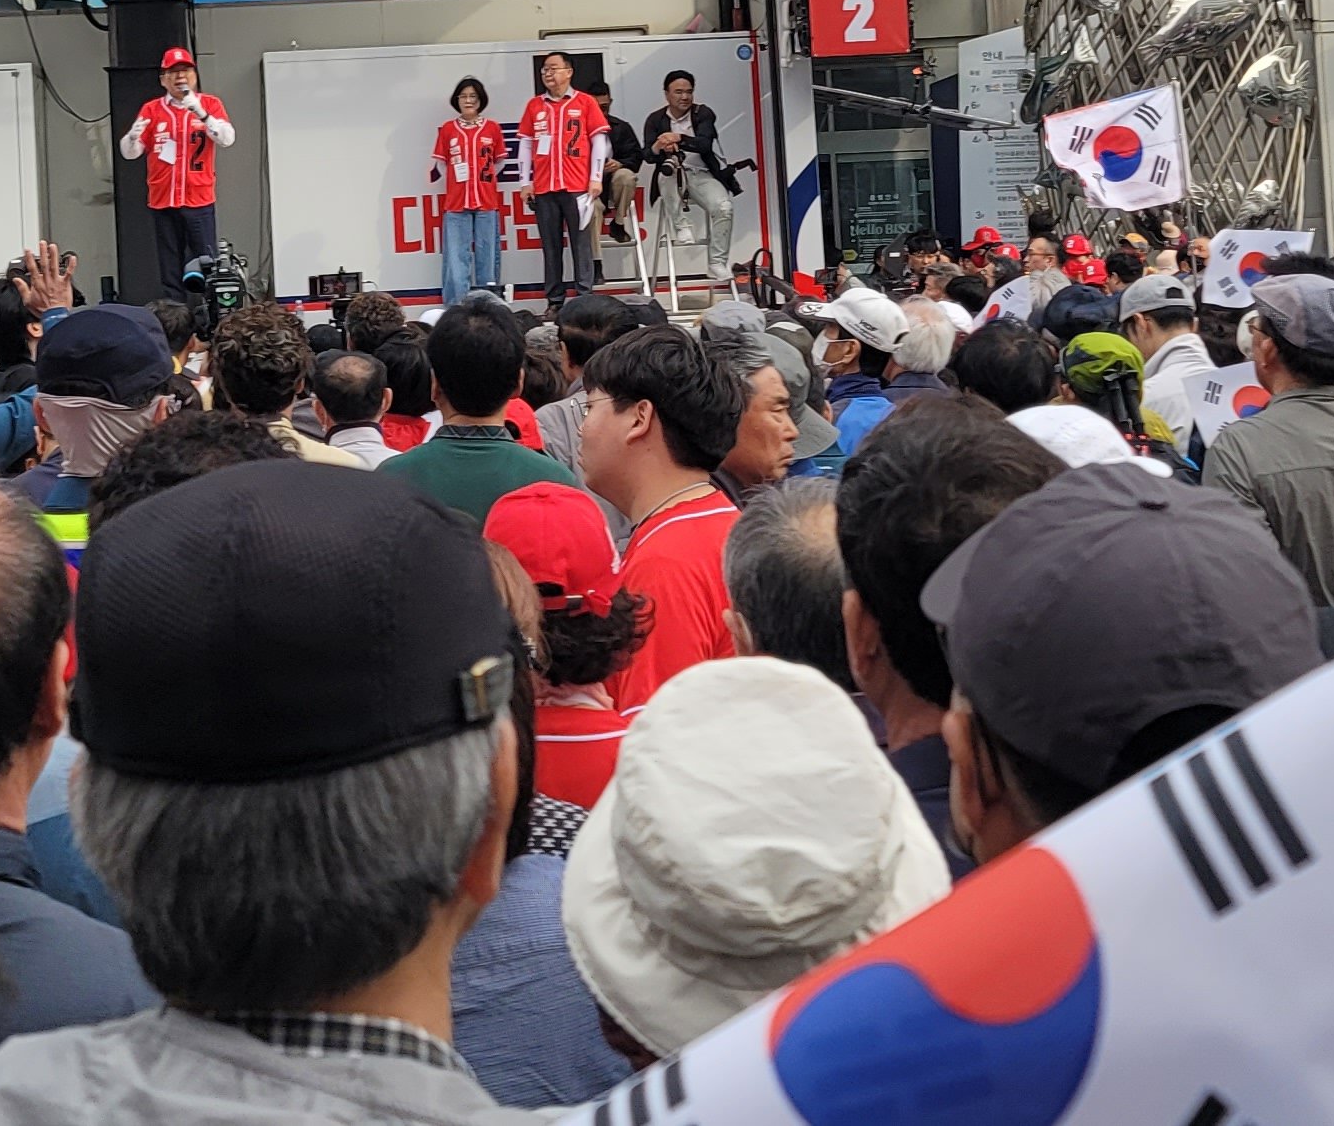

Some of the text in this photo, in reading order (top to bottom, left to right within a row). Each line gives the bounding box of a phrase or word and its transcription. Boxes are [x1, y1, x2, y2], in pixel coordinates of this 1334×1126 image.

[981, 51, 1004, 62] 안내
[190, 129, 208, 172] 2
[566, 117, 582, 158] 2
